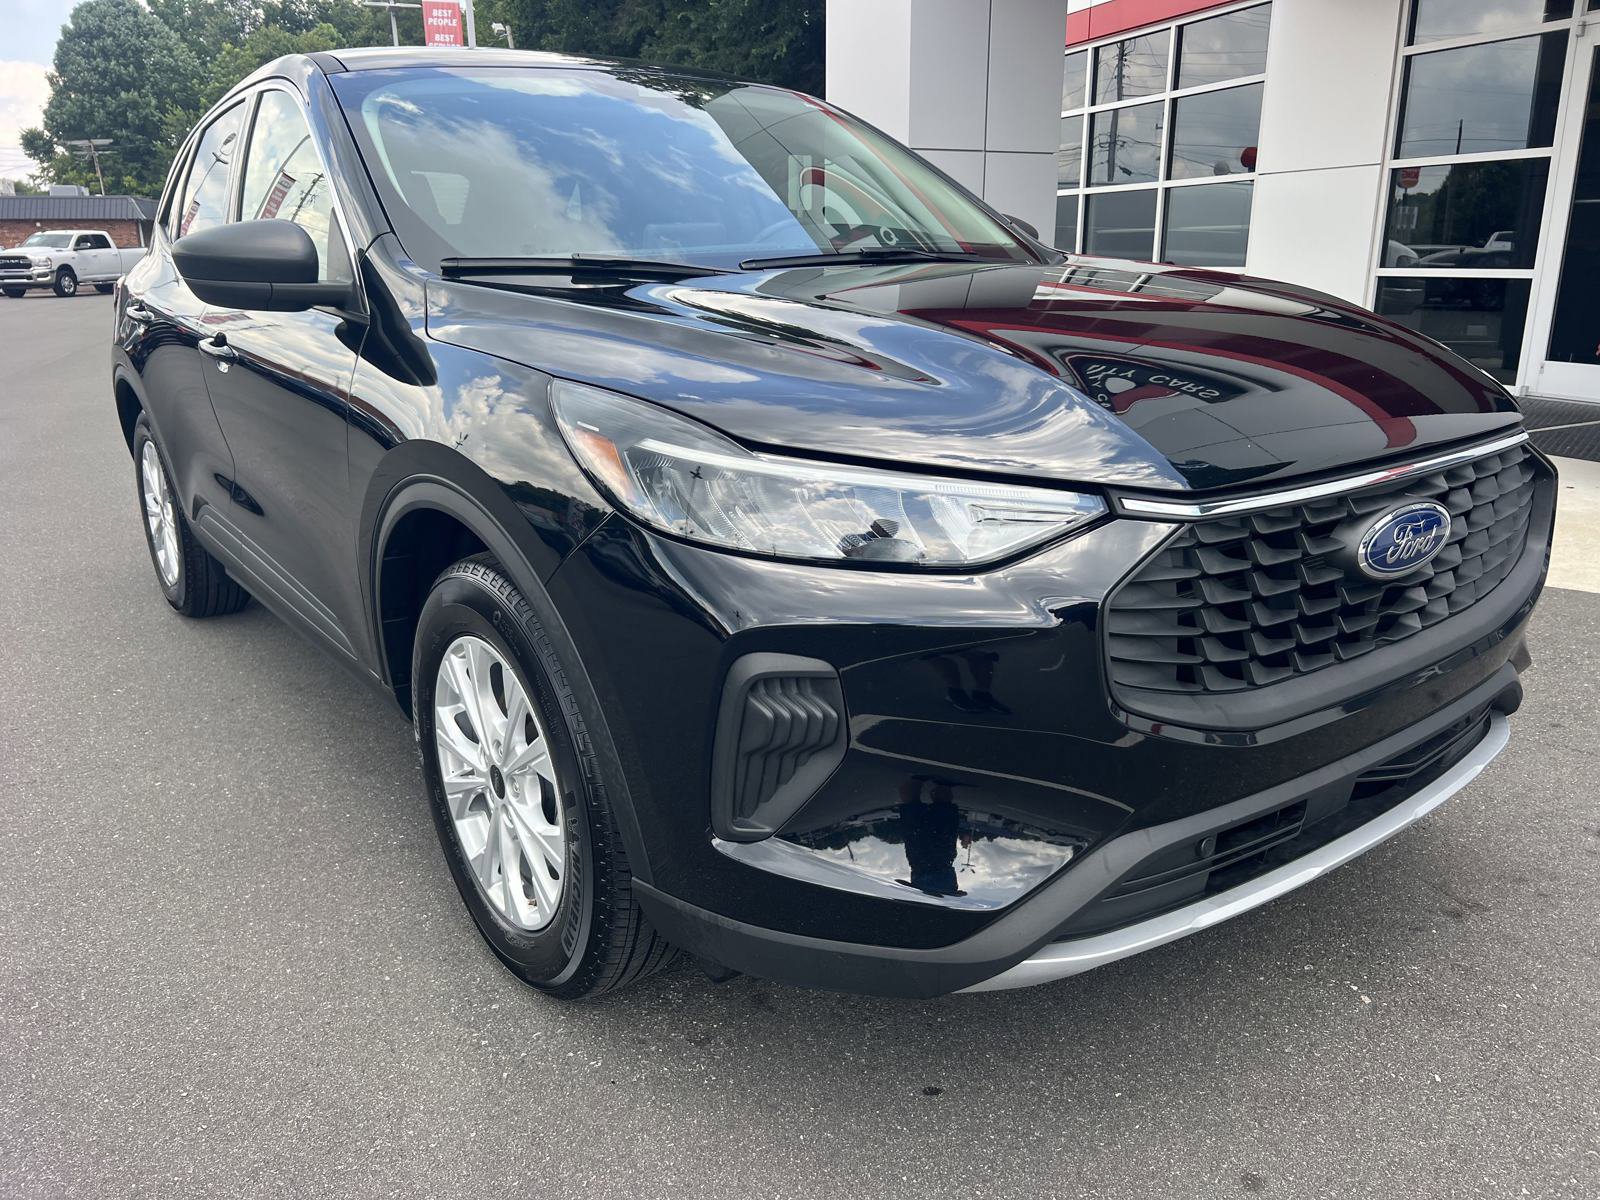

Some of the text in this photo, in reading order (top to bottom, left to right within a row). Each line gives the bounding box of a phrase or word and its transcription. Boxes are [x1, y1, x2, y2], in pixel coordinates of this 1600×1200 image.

[432, 8, 453, 17] BEST
[427, 17, 458, 26] PEOPLE
[434, 33, 455, 42] BEST
[1386, 519, 1438, 564] Ford
[563, 848, 583, 954] MICHELIN
